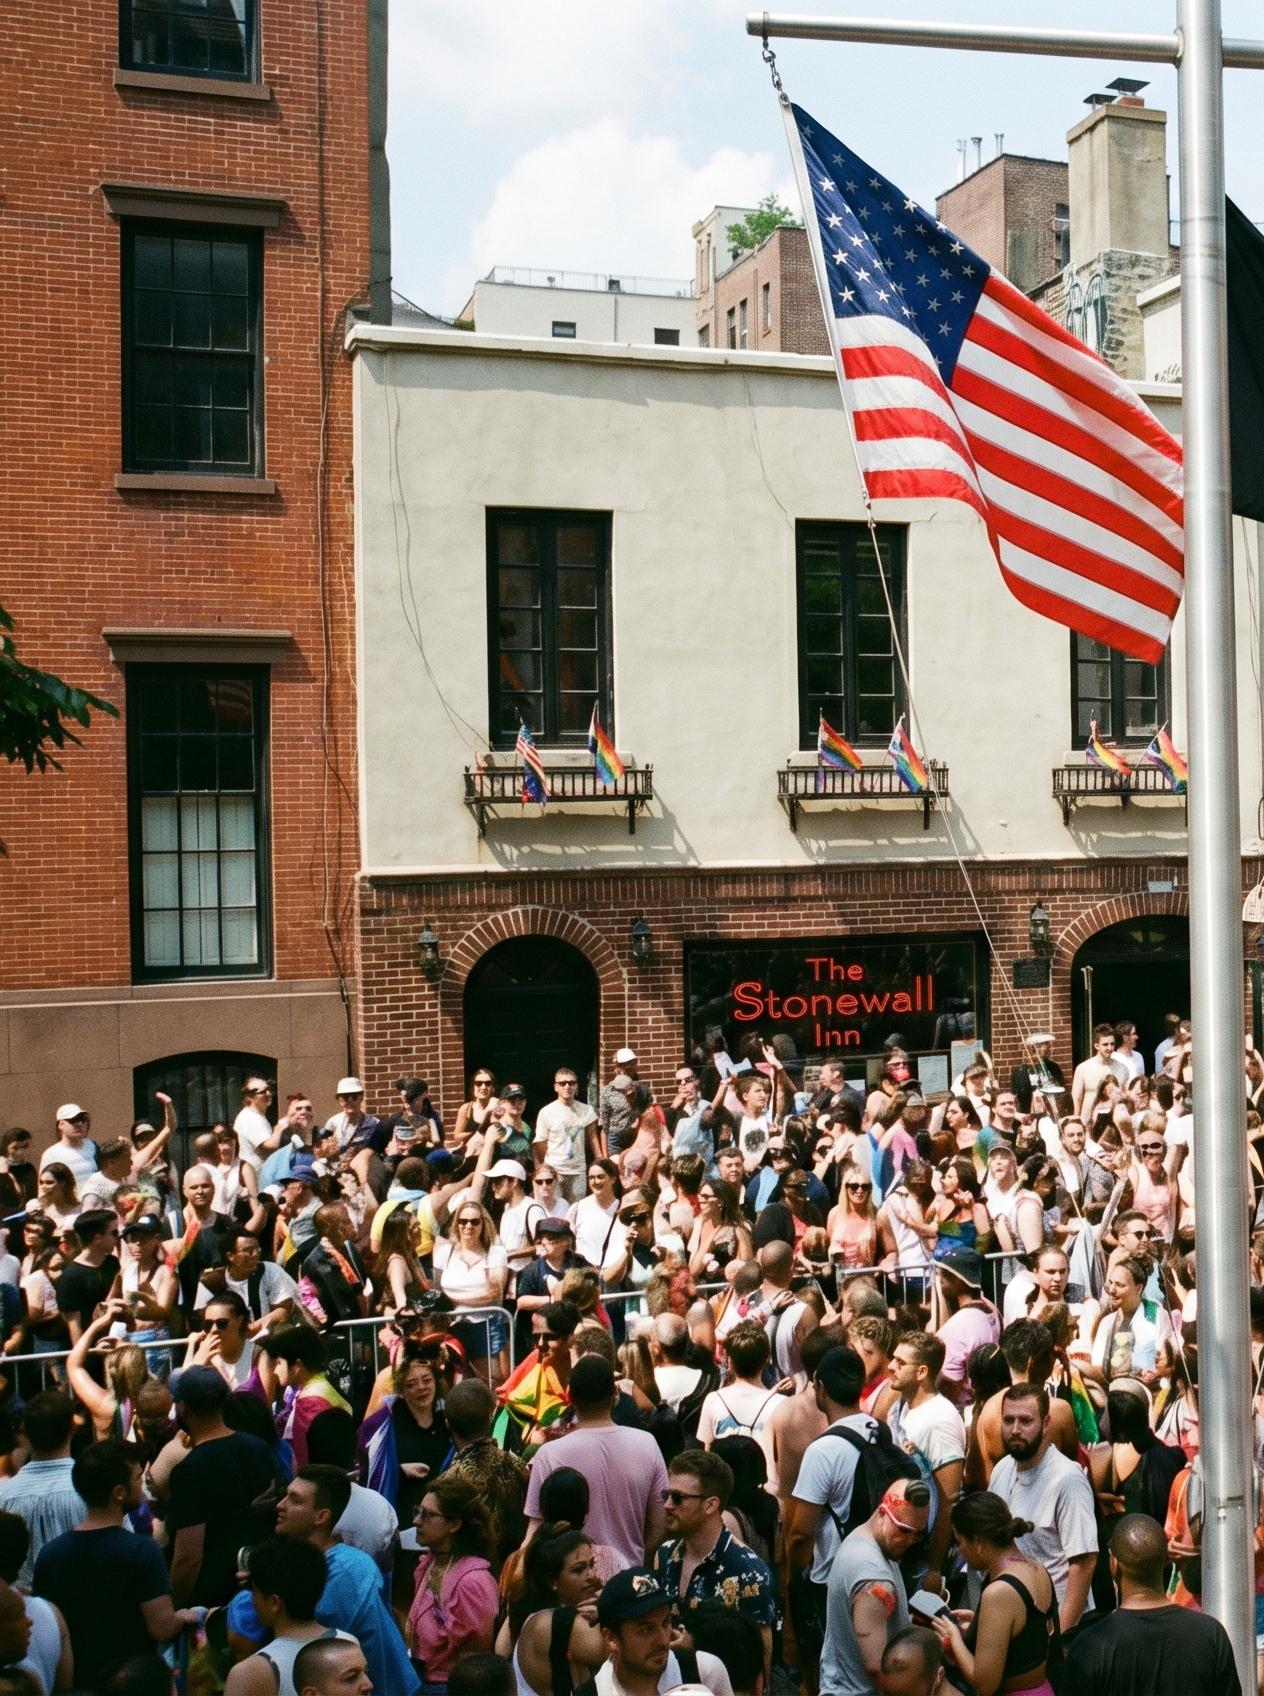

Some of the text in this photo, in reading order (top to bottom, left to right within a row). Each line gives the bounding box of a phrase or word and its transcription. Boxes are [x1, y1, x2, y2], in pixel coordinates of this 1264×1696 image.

[805, 956, 864, 982] The
[732, 974, 935, 1022] Stonewall
[814, 1023, 861, 1047] Inn
